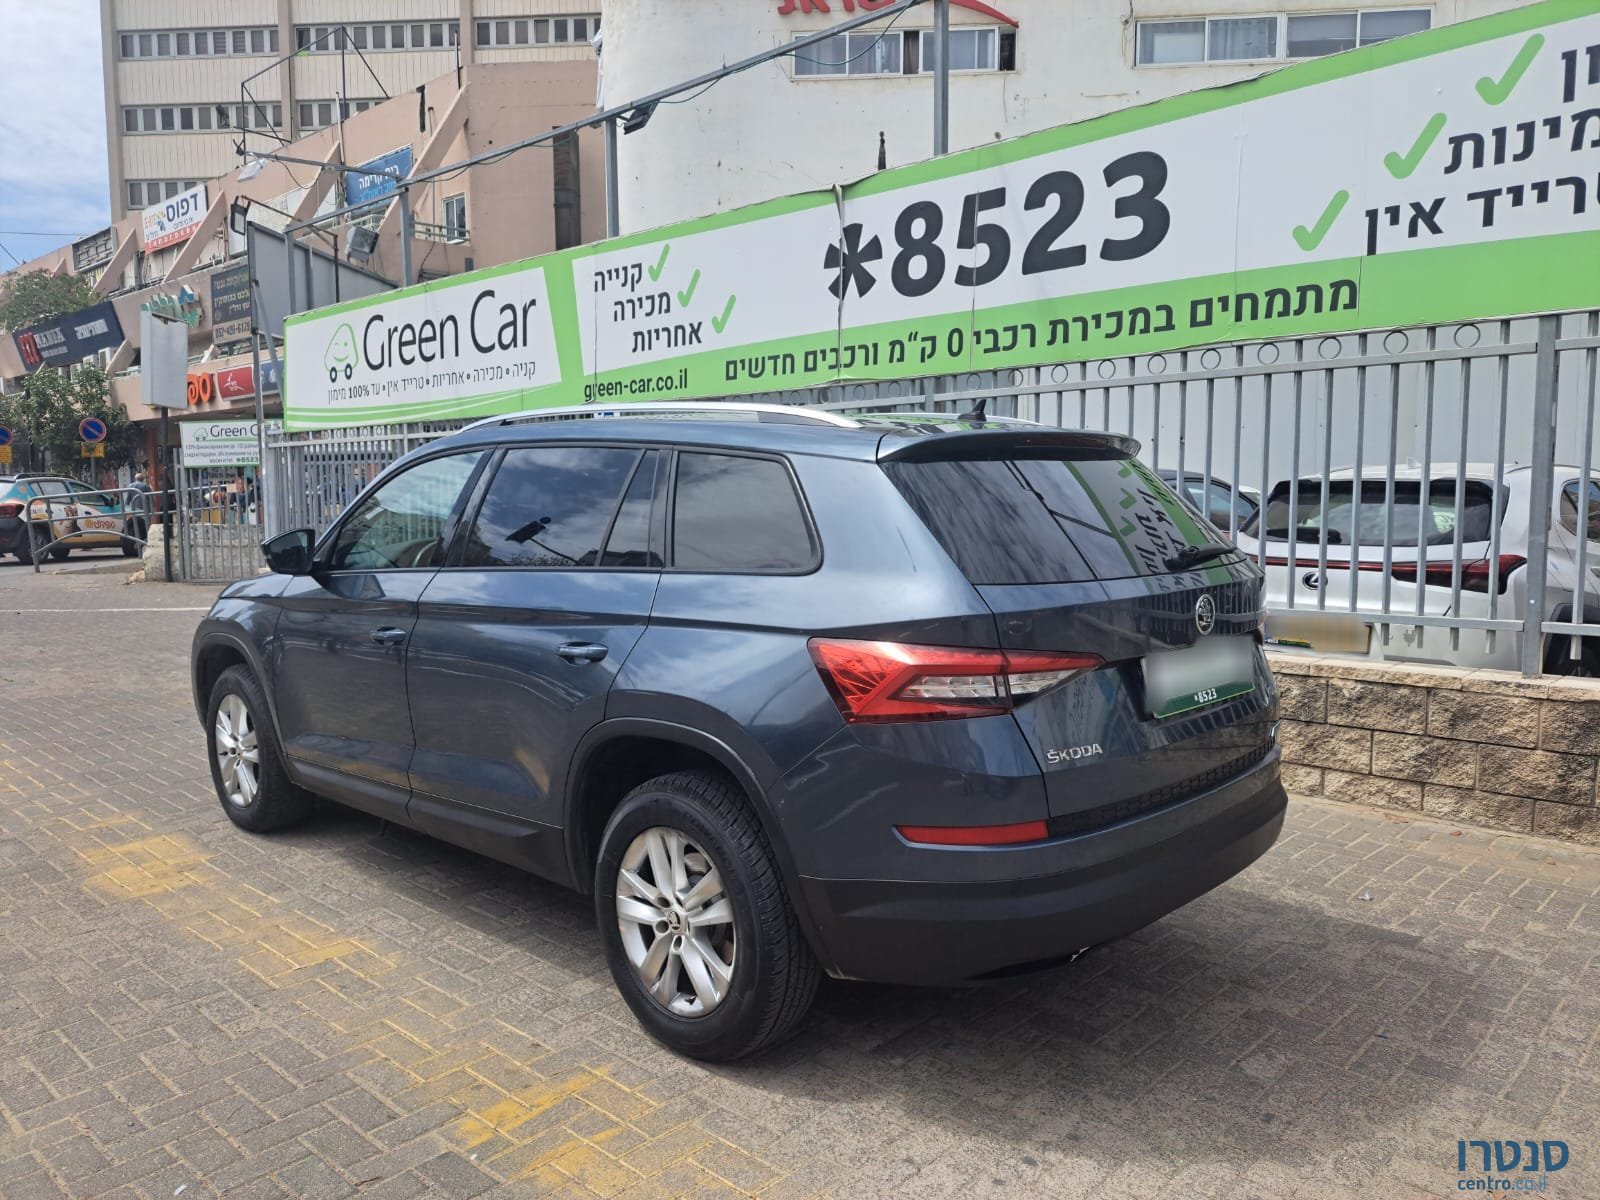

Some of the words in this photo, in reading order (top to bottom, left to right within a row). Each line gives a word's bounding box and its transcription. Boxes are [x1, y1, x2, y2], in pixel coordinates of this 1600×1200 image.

[166, 192, 198, 222] דפוס
[1466, 171, 1600, 228] רייד
[1365, 196, 1447, 256] אין
[594, 262, 643, 293] קנייה
[613, 291, 671, 322] מכירה
[1189, 278, 1358, 329] מתמחים
[363, 314, 460, 371] Green
[470, 289, 537, 354] Car
[632, 321, 703, 353] אחריות
[972, 322, 1036, 354] רכבי
[1047, 304, 1176, 347] במכירת
[803, 342, 879, 372] ורכבים
[888, 331, 937, 363] ק"מ
[947, 327, 963, 358] 0
[432, 369, 465, 388] אחריות
[473, 365, 503, 382] מכירה
[512, 360, 536, 382] קניה
[725, 353, 796, 381] חדשים
[327, 388, 347, 405] מימון
[348, 384, 370, 399] 100%
[371, 382, 381, 397] עד
[386, 379, 399, 398] אין
[401, 376, 424, 392] טרייד
[584, 367, 688, 402] green-car.co.il
[210, 424, 247, 437] Green
[1047, 743, 1103, 764] ŠKODA
